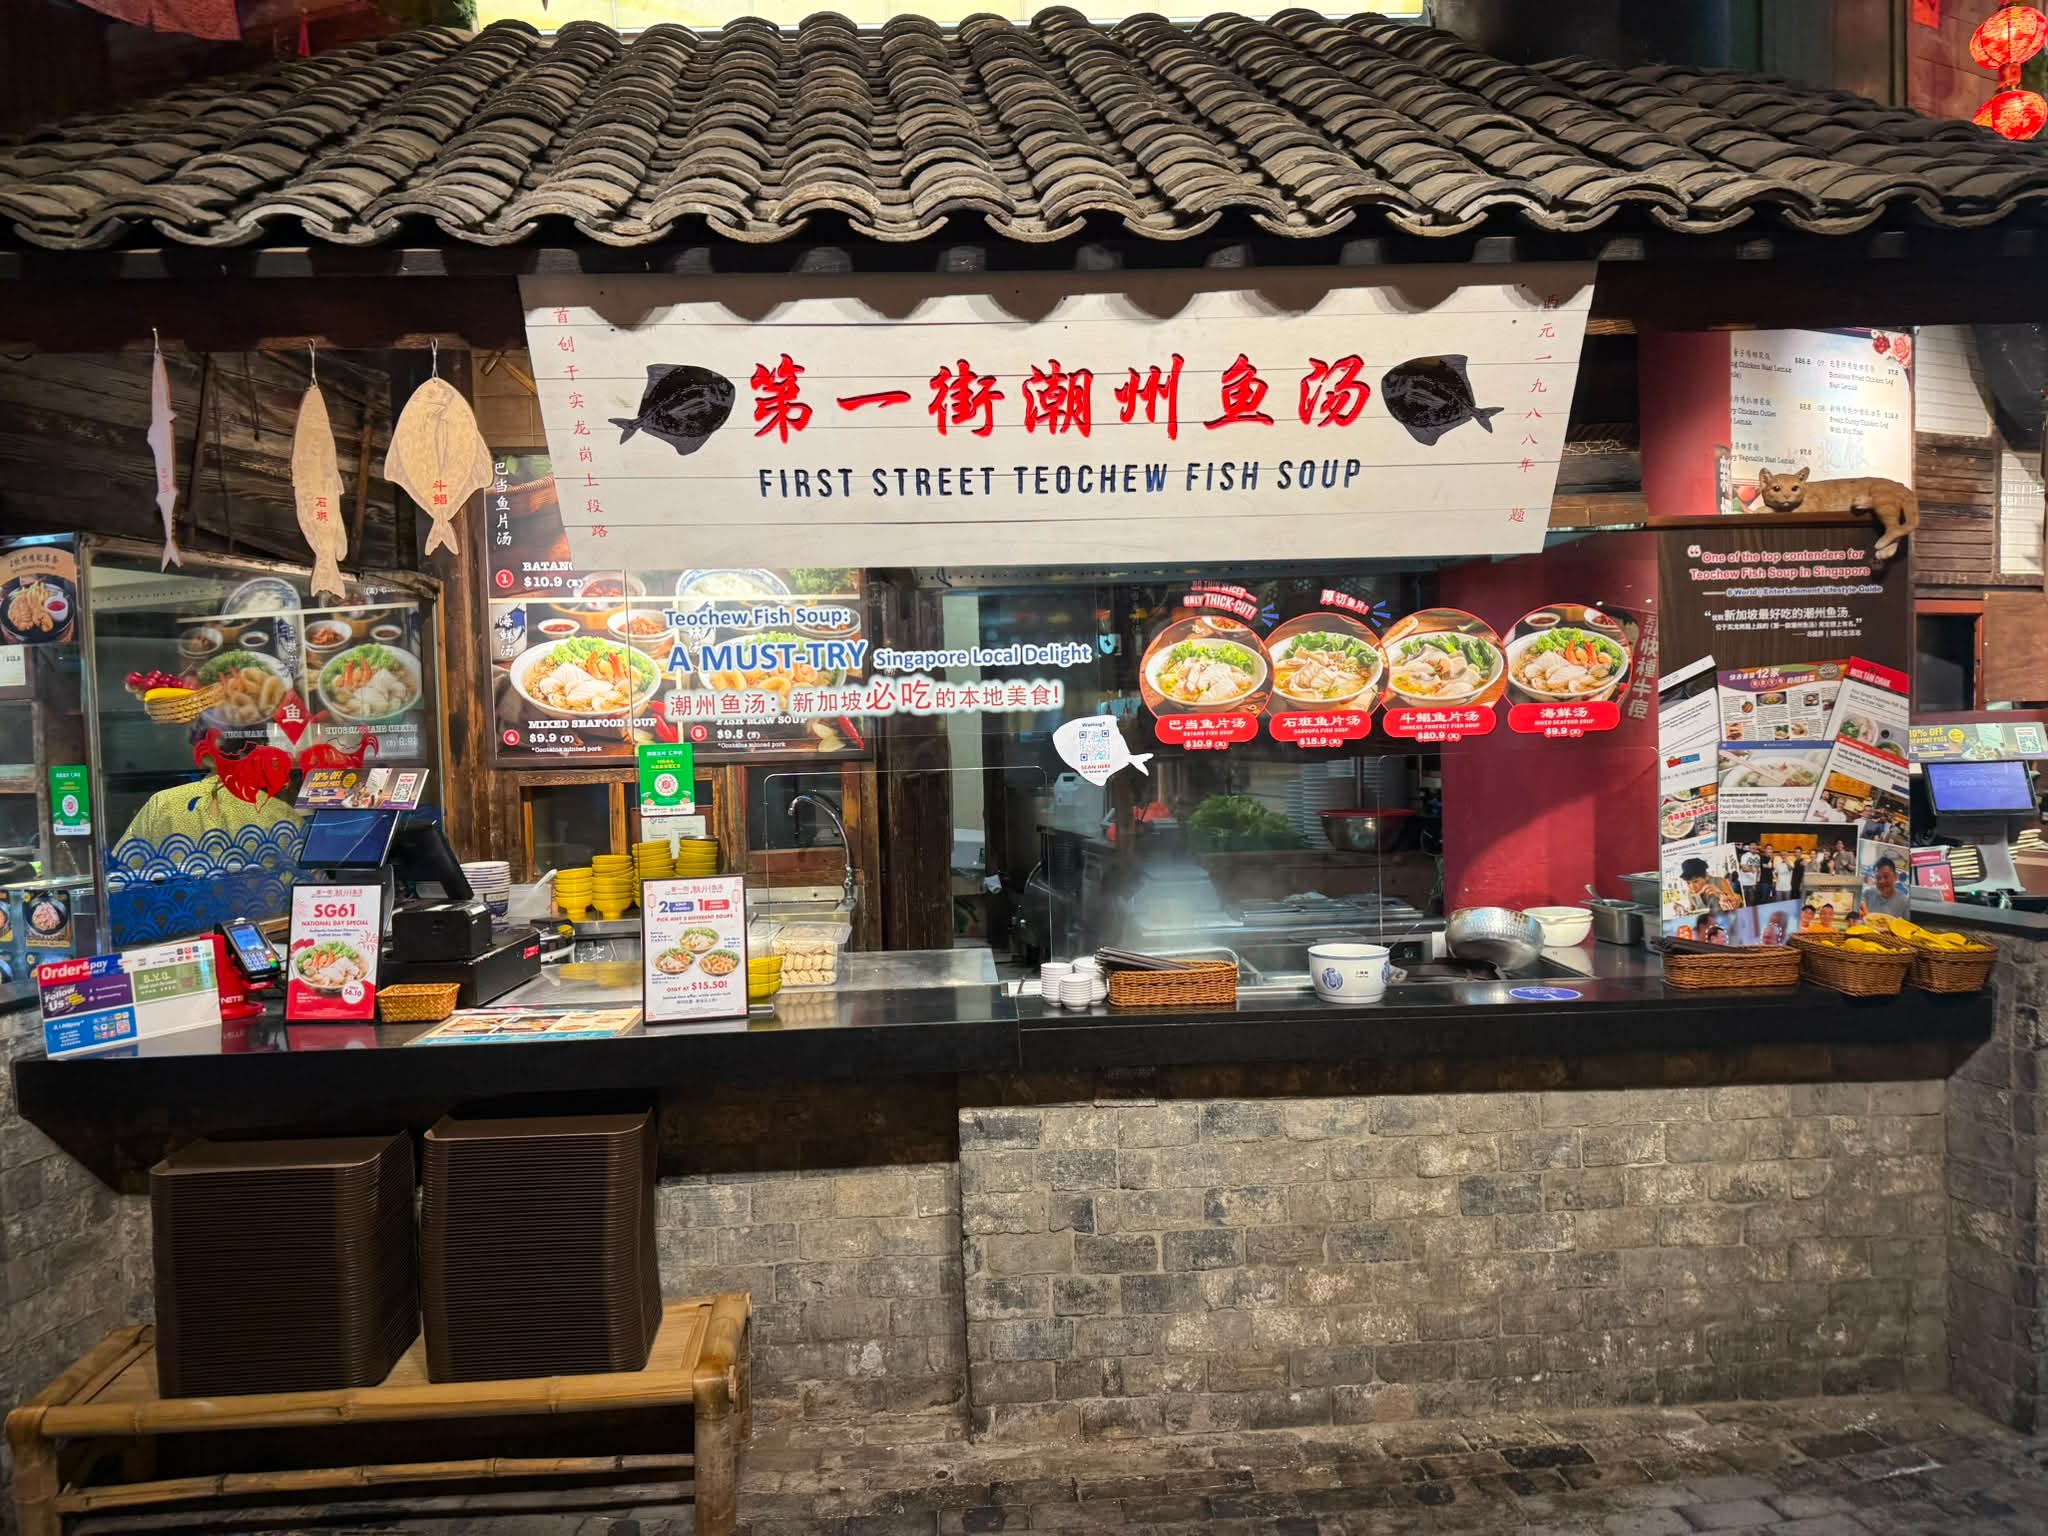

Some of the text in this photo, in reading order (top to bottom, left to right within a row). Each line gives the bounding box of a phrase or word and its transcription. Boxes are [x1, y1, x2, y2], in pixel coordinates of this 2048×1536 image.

[751, 352, 1372, 444] 第一街潮州鱼汤
[758, 458, 1362, 499] FIRST STREET TEOCHEW FISH SOUP
[494, 462, 512, 546] 巴当鱼片汤
[1728, 551, 1740, 562] of
[1741, 551, 1760, 562] the
[1761, 551, 1781, 564] top
[1783, 549, 1846, 561] contenders
[1847, 548, 1864, 560] for
[1689, 565, 1871, 580] Teochew Fish Soup in Singapore
[523, 575, 562, 588] $10.9
[665, 606, 850, 627] Teochew Fish Soup:
[667, 642, 1092, 673] A MUST-TRY Singapore Local Delight
[282, 703, 304, 724] 鱼
[1540, 707, 1588, 718] 海鲜汤
[528, 717, 658, 730] MIXED SEAFOOD SOUP
[1168, 718, 1246, 730] 巴当鱼片汤
[1282, 715, 1361, 728] 石斑鱼片汤
[529, 733, 557, 744] $9.9
[1546, 727, 1568, 735] $9.9
[587, 746, 603, 754] pork
[314, 903, 356, 918] SG61
